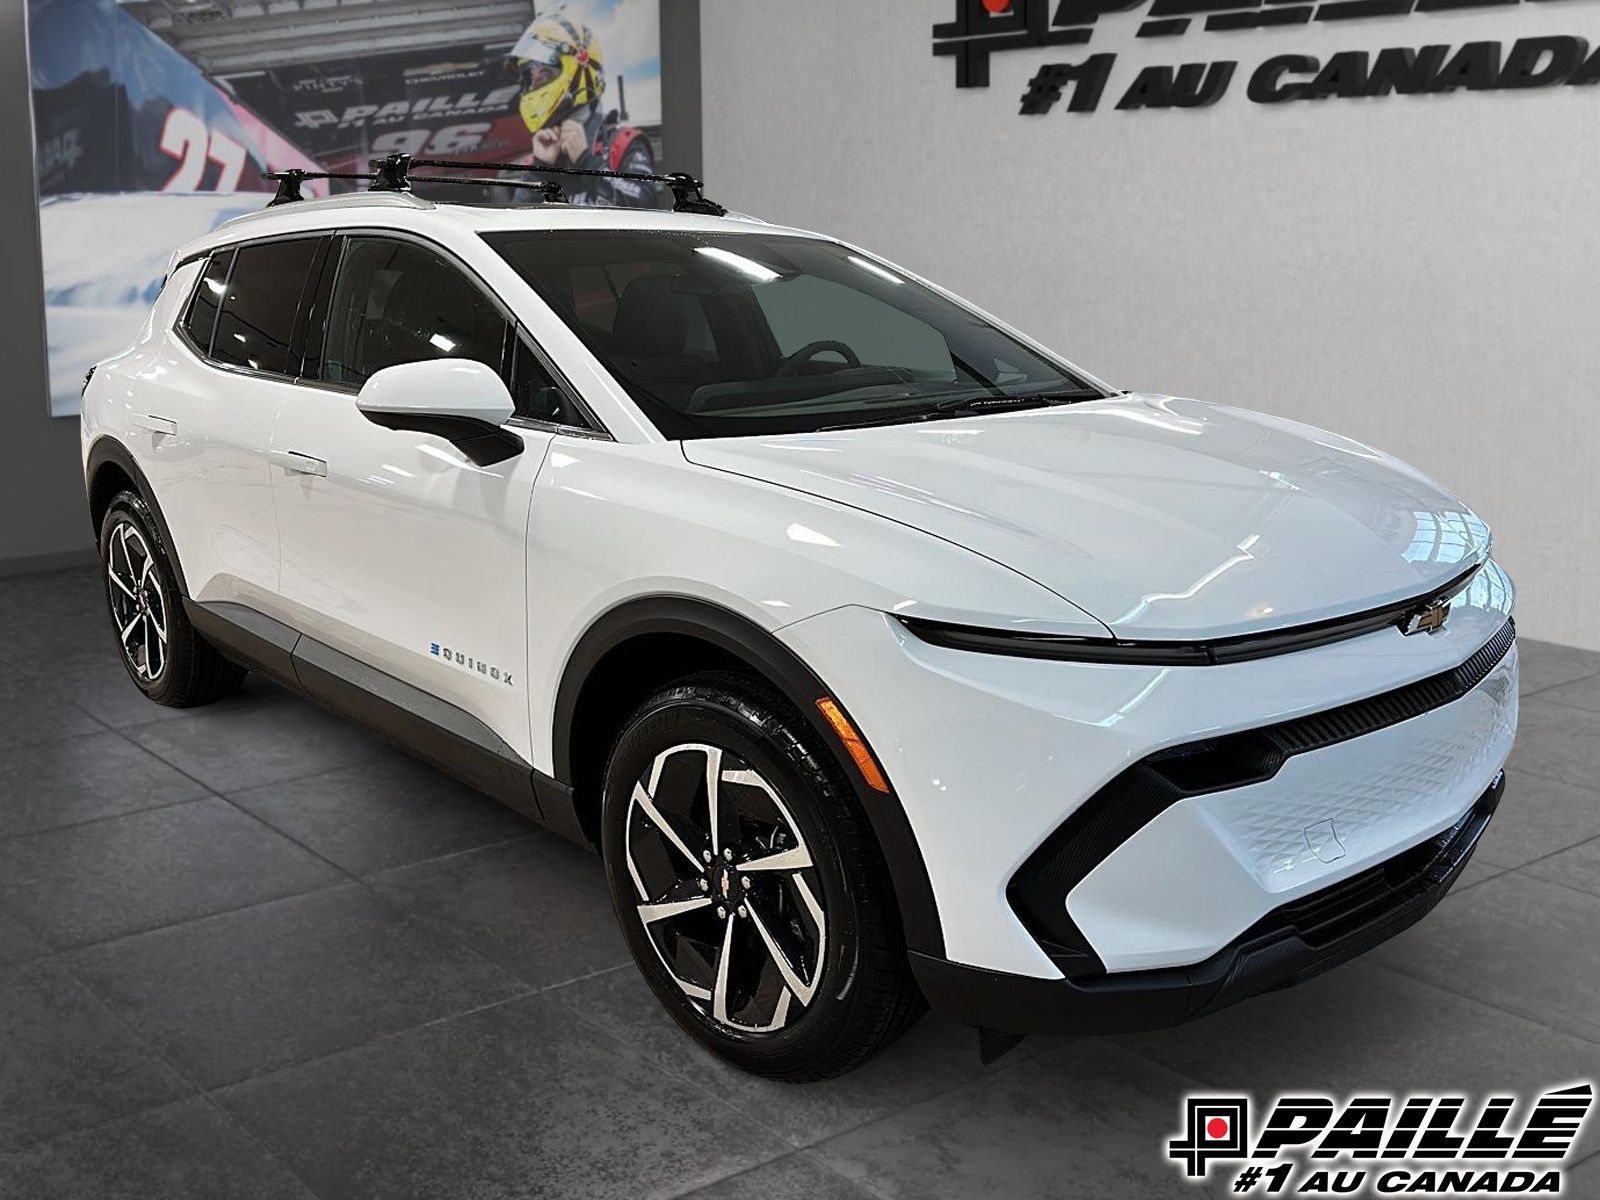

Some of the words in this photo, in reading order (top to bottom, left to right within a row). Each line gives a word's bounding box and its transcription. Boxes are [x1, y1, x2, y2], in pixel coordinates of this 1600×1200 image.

[1019, 53, 1117, 115] #1
[1114, 61, 1238, 110] AU
[159, 106, 246, 192] 27
[369, 123, 492, 163] 96
